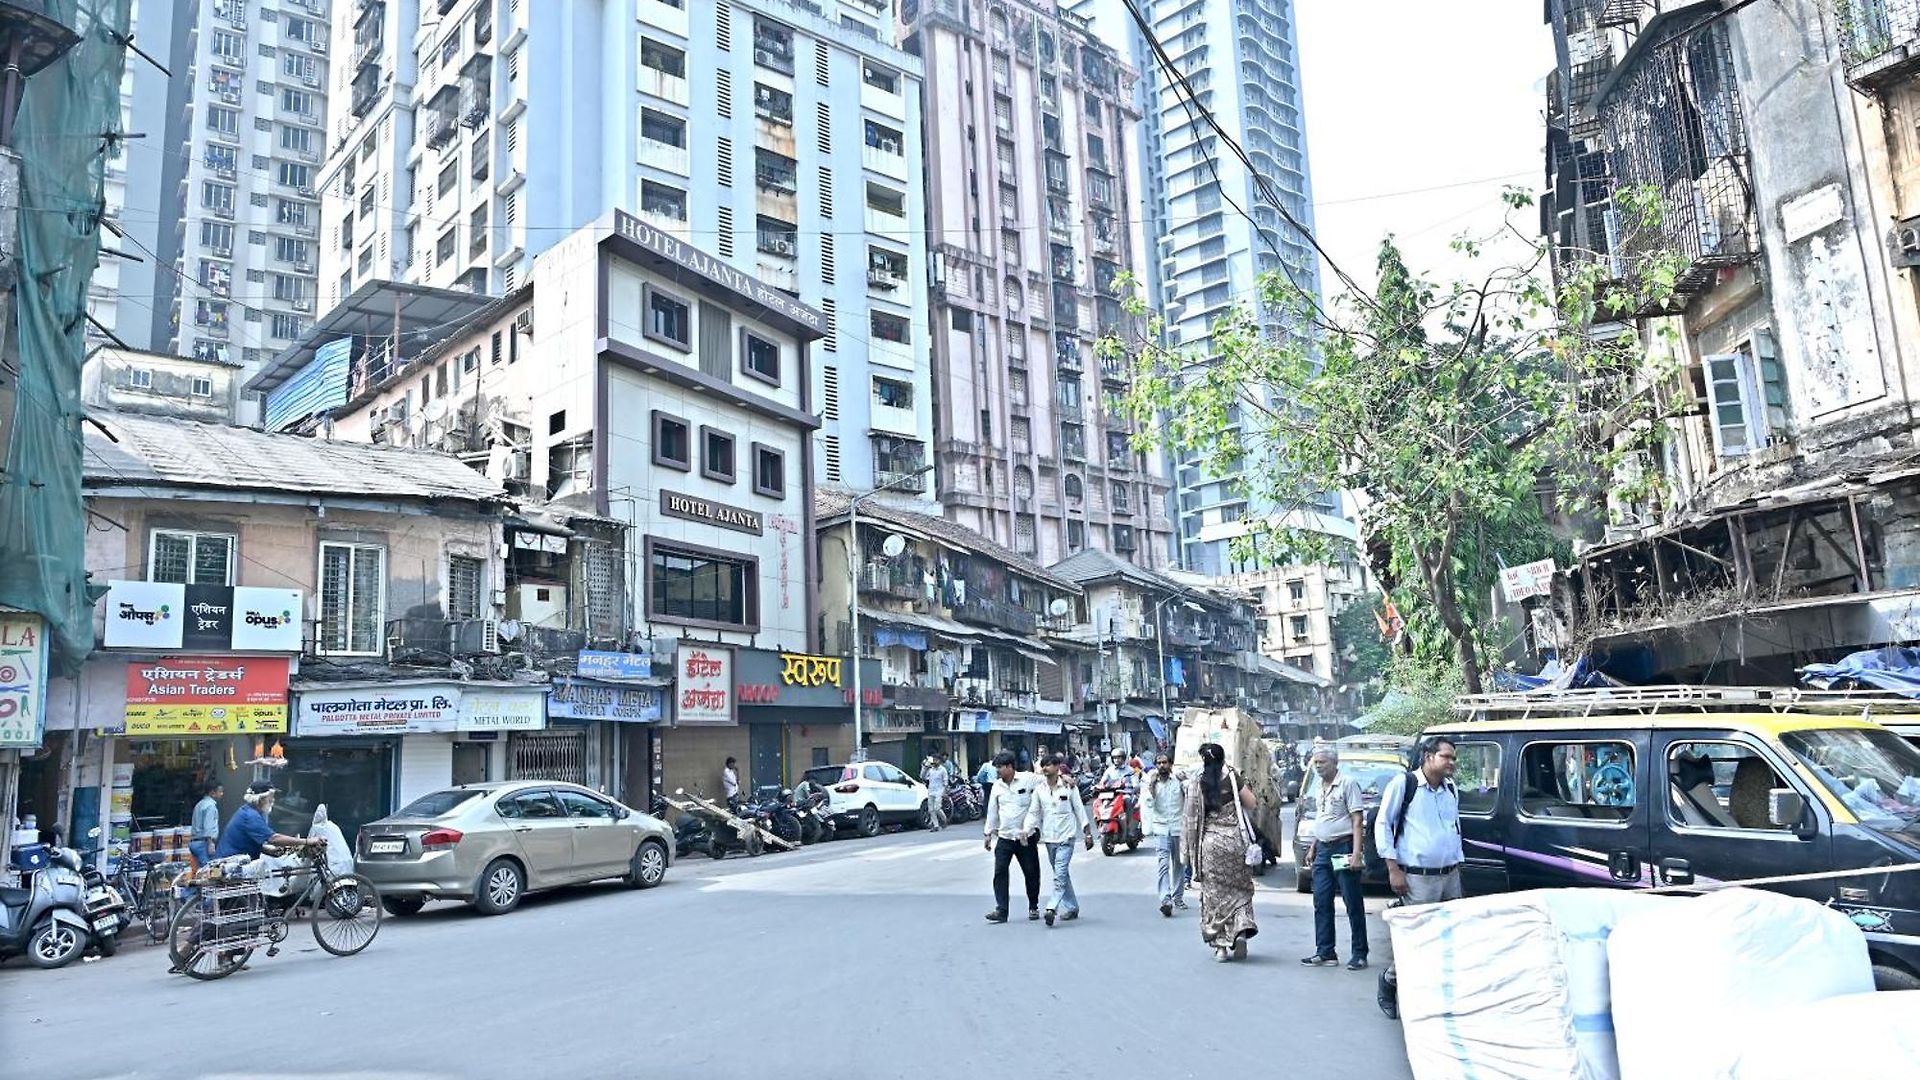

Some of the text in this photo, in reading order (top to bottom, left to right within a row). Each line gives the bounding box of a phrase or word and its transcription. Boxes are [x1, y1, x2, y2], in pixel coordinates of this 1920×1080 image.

[622, 215, 754, 300] HOTEL AJANTA
[670, 496, 713, 518] HOTEL
[716, 508, 759, 529] AJANTA
[190, 602, 227, 616] एशियन
[141, 666, 245, 682] एशियन ट्रेडर्स
[781, 653, 842, 688] स्वरूप
[148, 684, 236, 695] Asian Traders
[310, 695, 452, 713] पालगोता मेटल प्रा. लि.
[359, 713, 381, 721] METAL
[383, 712, 413, 720] PRIVATE
[414, 711, 441, 719] LIMITED
[474, 716, 531, 725] METAL WORLD
